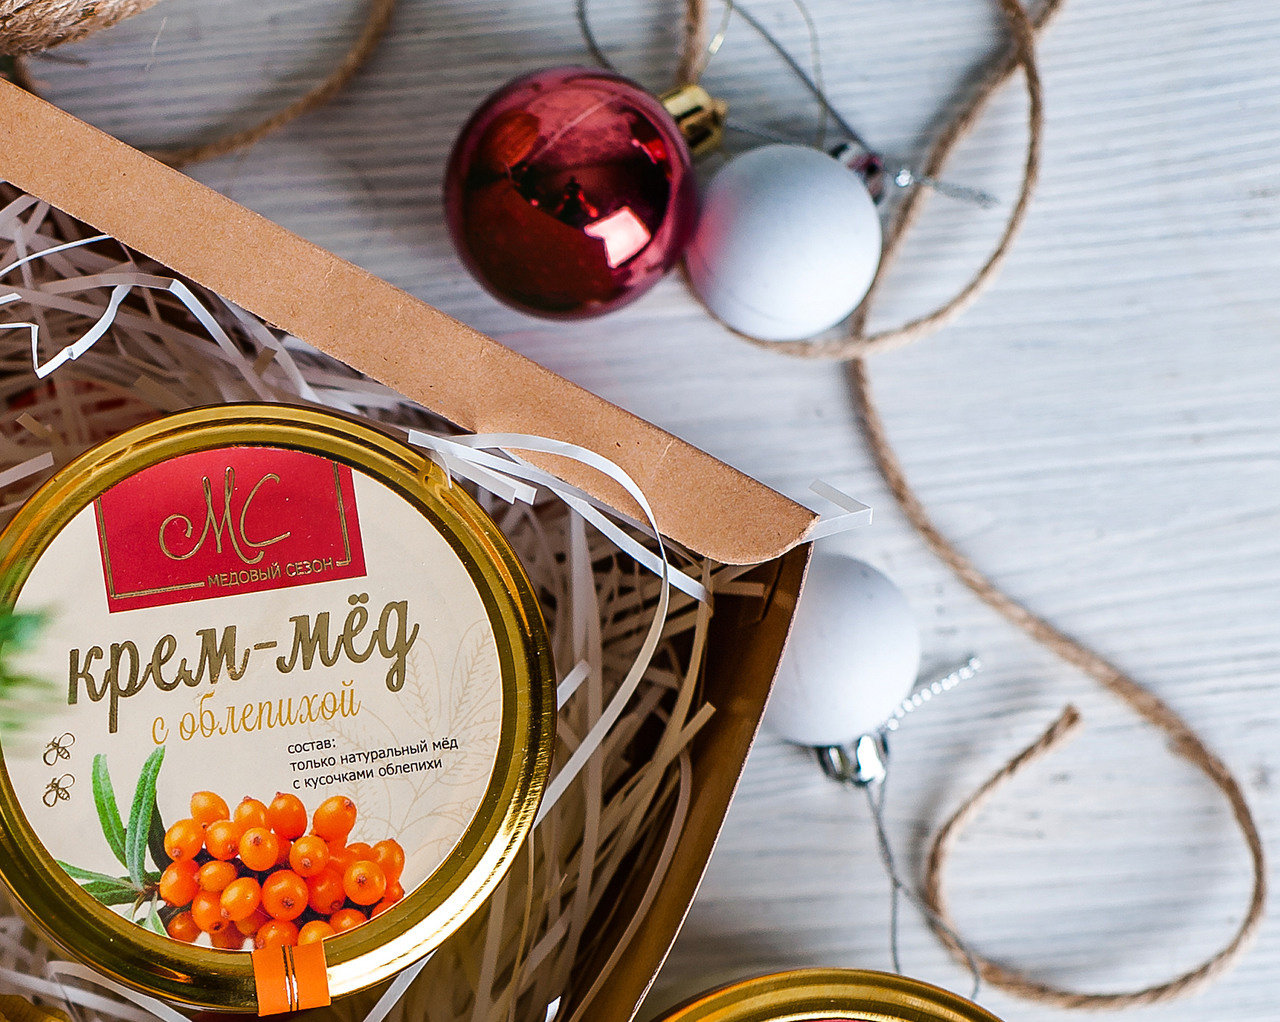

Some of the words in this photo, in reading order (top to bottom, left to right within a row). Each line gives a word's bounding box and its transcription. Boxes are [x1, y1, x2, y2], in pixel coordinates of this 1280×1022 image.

[207, 562, 282, 588] МЕДОВЫЙ
[285, 557, 334, 577] СЕЗОН
[66, 592, 420, 733] крем-мёд
[151, 713, 170, 745] с
[179, 679, 362, 739] облепихой
[287, 737, 337, 754] состав:
[289, 755, 336, 772] только
[340, 739, 429, 763] натуральный
[432, 737, 459, 752] мёд
[292, 779, 301, 789] с
[304, 768, 374, 789] кусочками
[378, 758, 443, 777] облепихи
